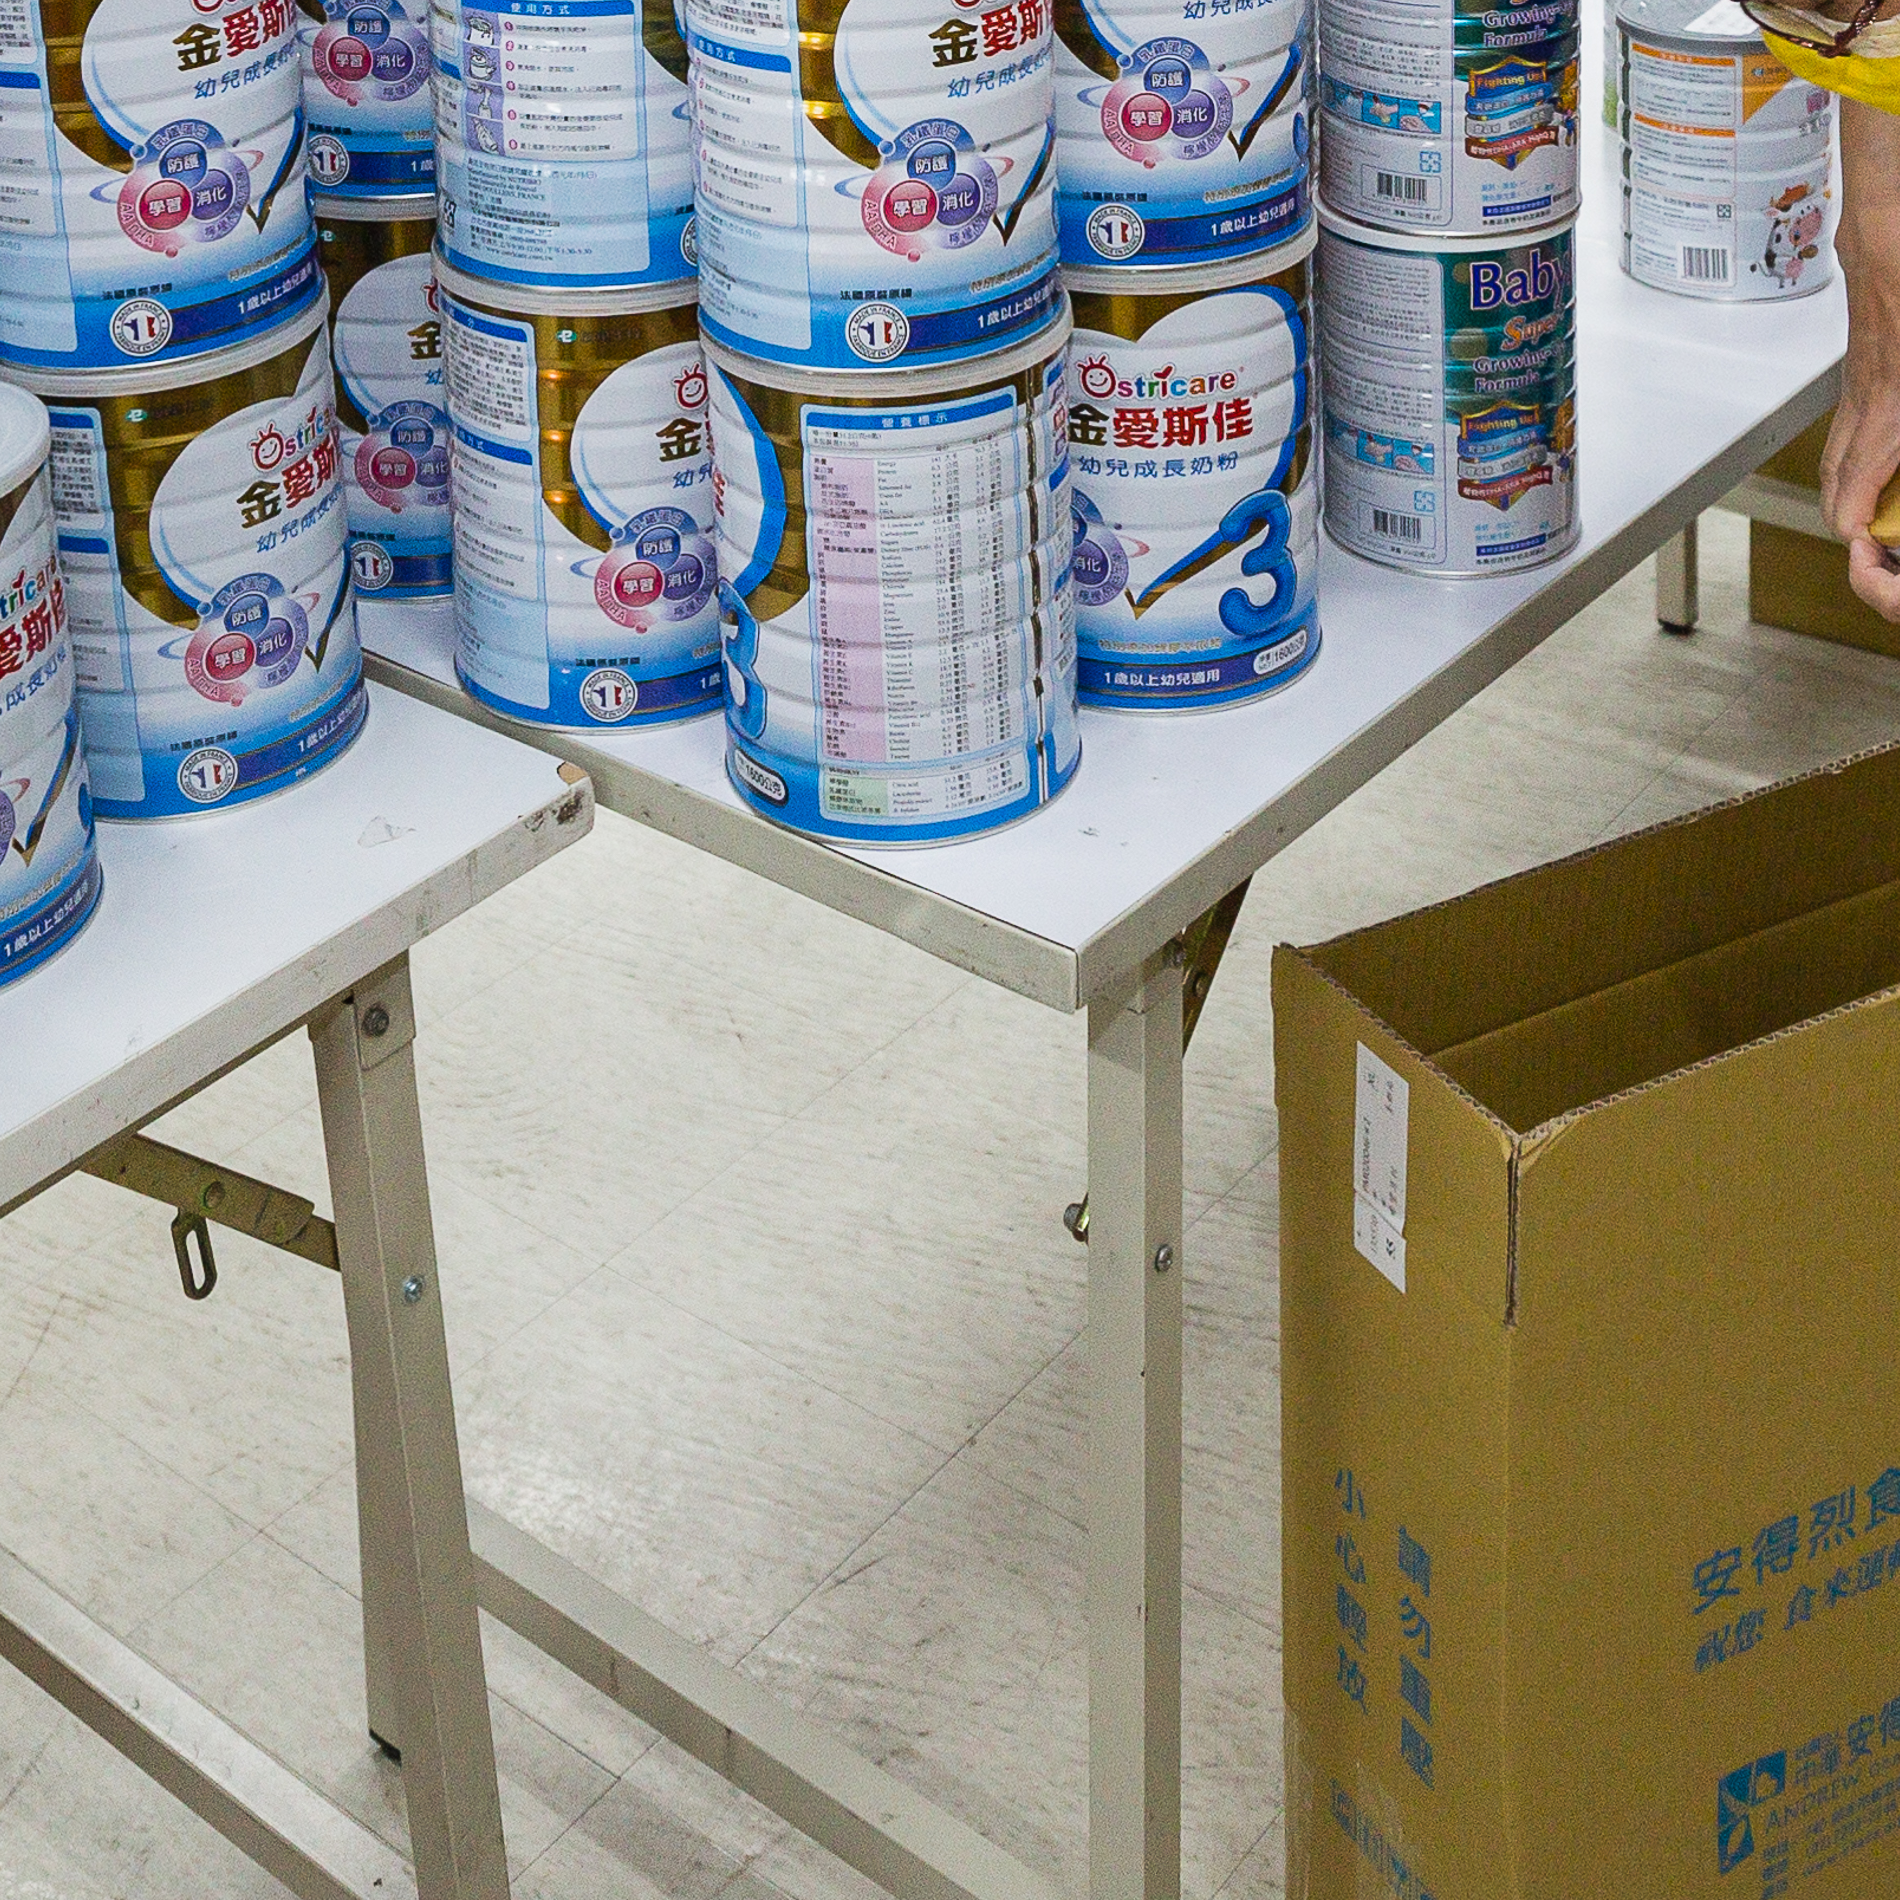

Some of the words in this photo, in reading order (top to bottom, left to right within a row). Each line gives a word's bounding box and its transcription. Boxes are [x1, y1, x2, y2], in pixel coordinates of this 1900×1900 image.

[1137, 39, 1195, 63] 乳鐵蛋白
[902, 120, 961, 148] 乳鐵蛋白
[1176, 108, 1208, 125] 消化
[195, 185, 227, 206] 消化
[942, 190, 975, 212] 消化
[1470, 249, 1564, 311] Baby
[1076, 353, 1236, 399] Ostricare
[655, 416, 702, 461] 金
[1068, 397, 1254, 448] 金愛斯佳
[1078, 451, 1238, 478] 幼兒成長奶粉
[1218, 489, 1297, 636] 3
[1103, 669, 1220, 686] 1歲以上幼兒適用
[1332, 1468, 1369, 1716] 小心輕放
[1763, 1762, 1861, 1836] ANDREW
